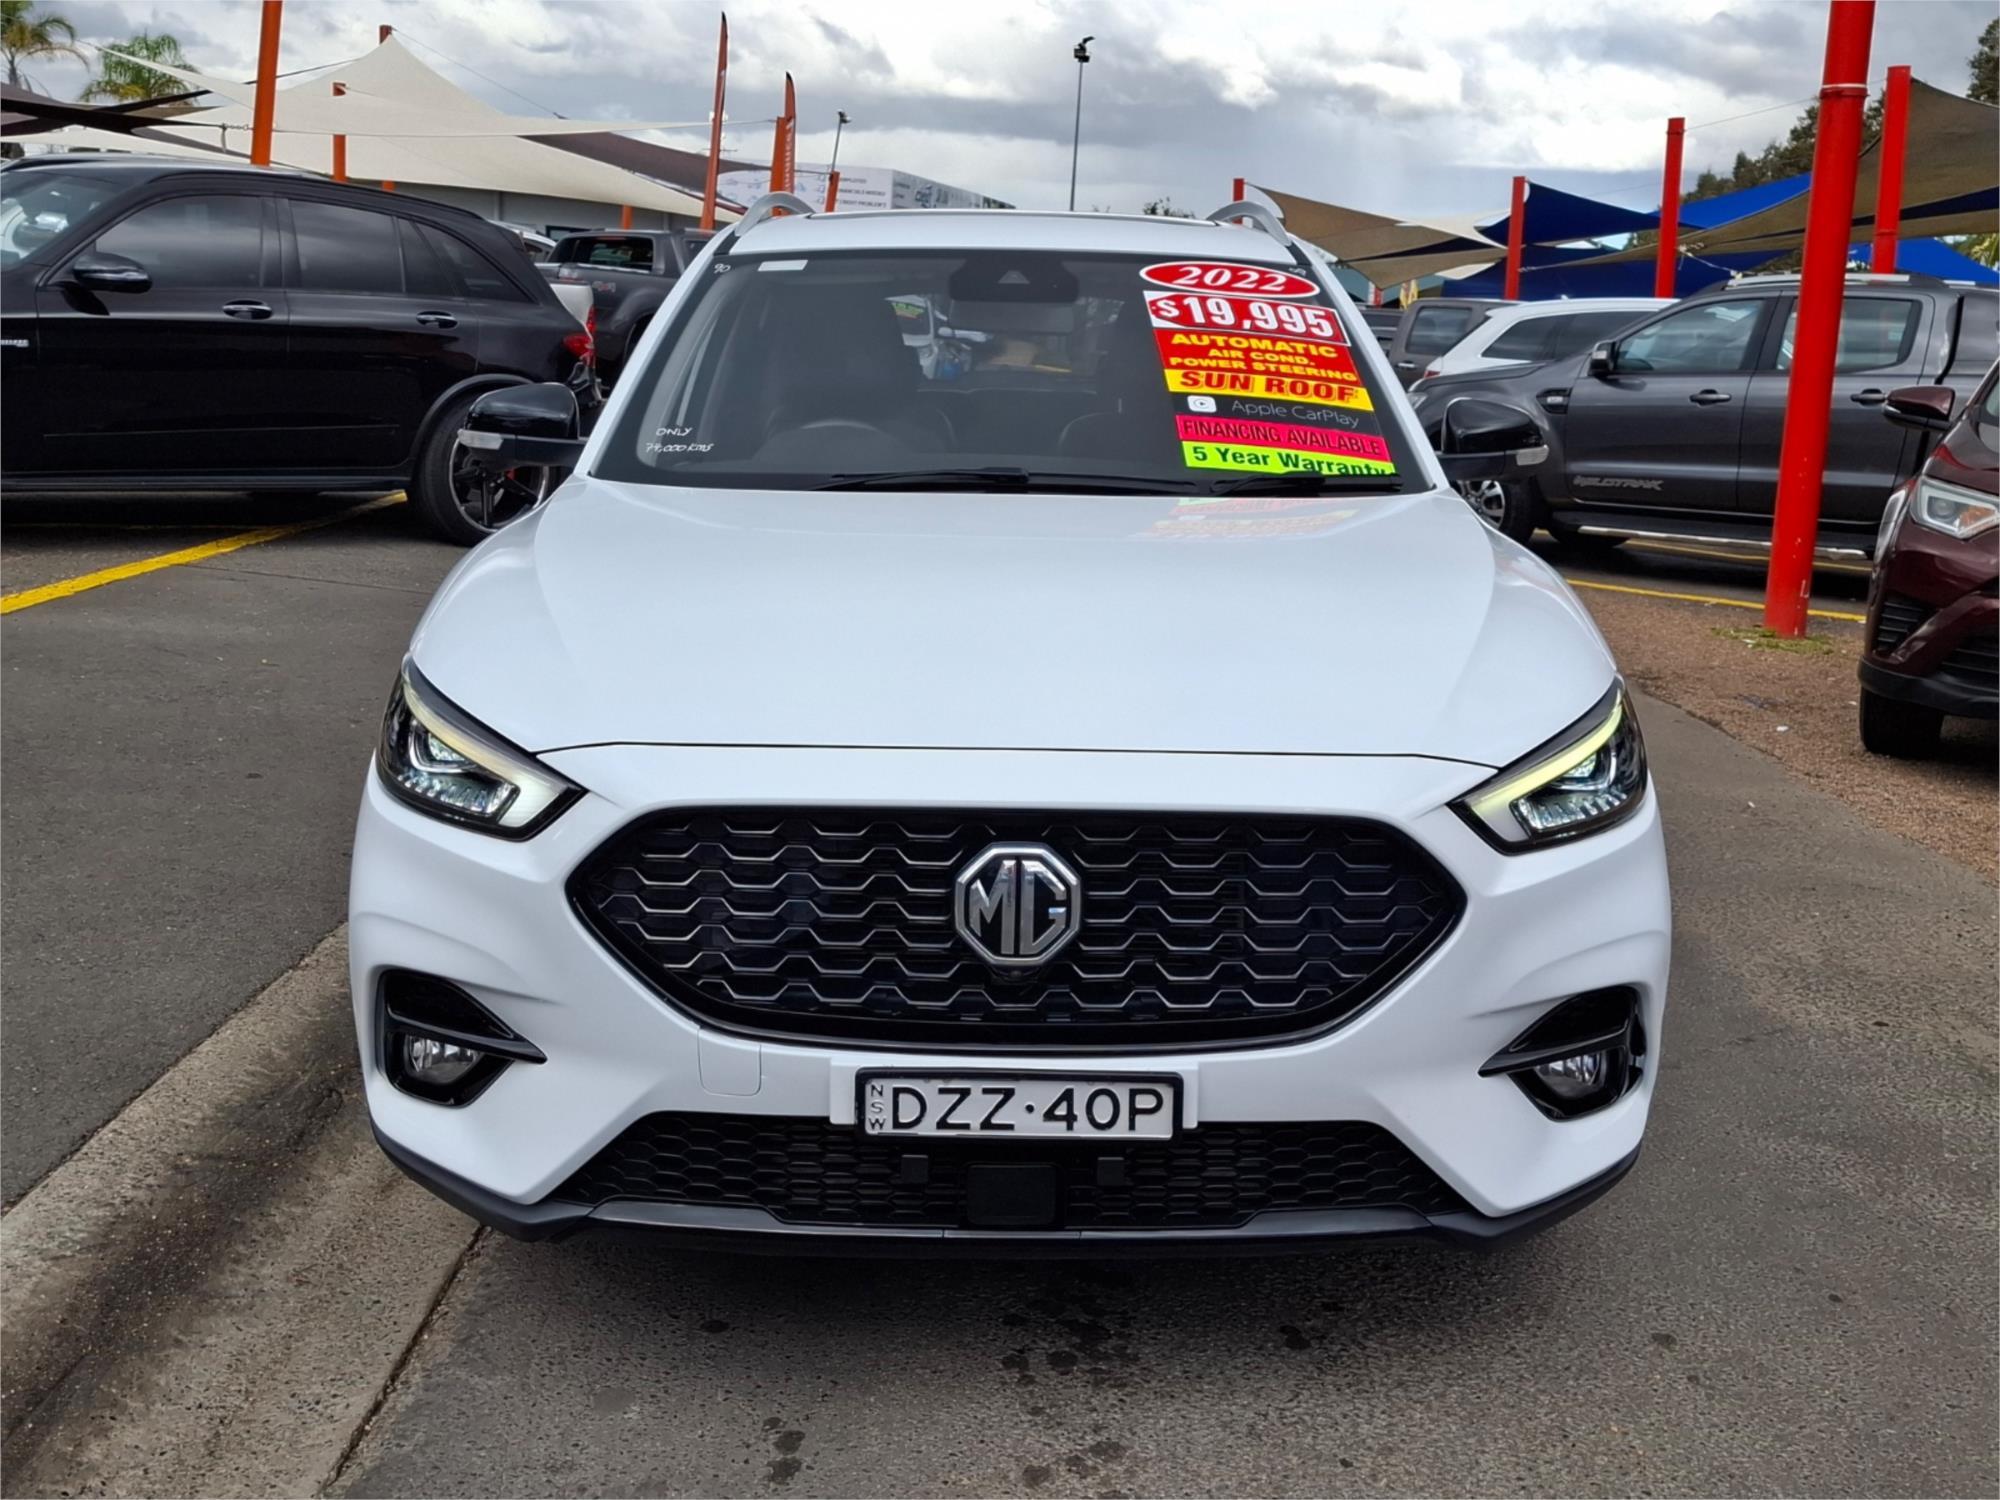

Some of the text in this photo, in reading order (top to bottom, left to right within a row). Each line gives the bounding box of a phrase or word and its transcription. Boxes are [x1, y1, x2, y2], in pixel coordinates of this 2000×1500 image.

[1172, 266, 1287, 292] 2022
[1156, 296, 1334, 338] $19,995
[1171, 333, 1338, 358] AUTOMATIC
[1208, 348, 1315, 366] AIR COND.
[1169, 357, 1358, 382] POWER STEERING
[1180, 371, 1358, 403] SUN ROOF
[1231, 400, 1360, 429] Apple CarPlay
[655, 427, 693, 436] ONLY
[1184, 419, 1381, 456] FINANCING AVAILABLE
[1192, 446, 1208, 461] 5
[1215, 447, 1270, 467] Year
[969, 859, 1067, 955] MG
[869, 1083, 887, 1132] NSW
